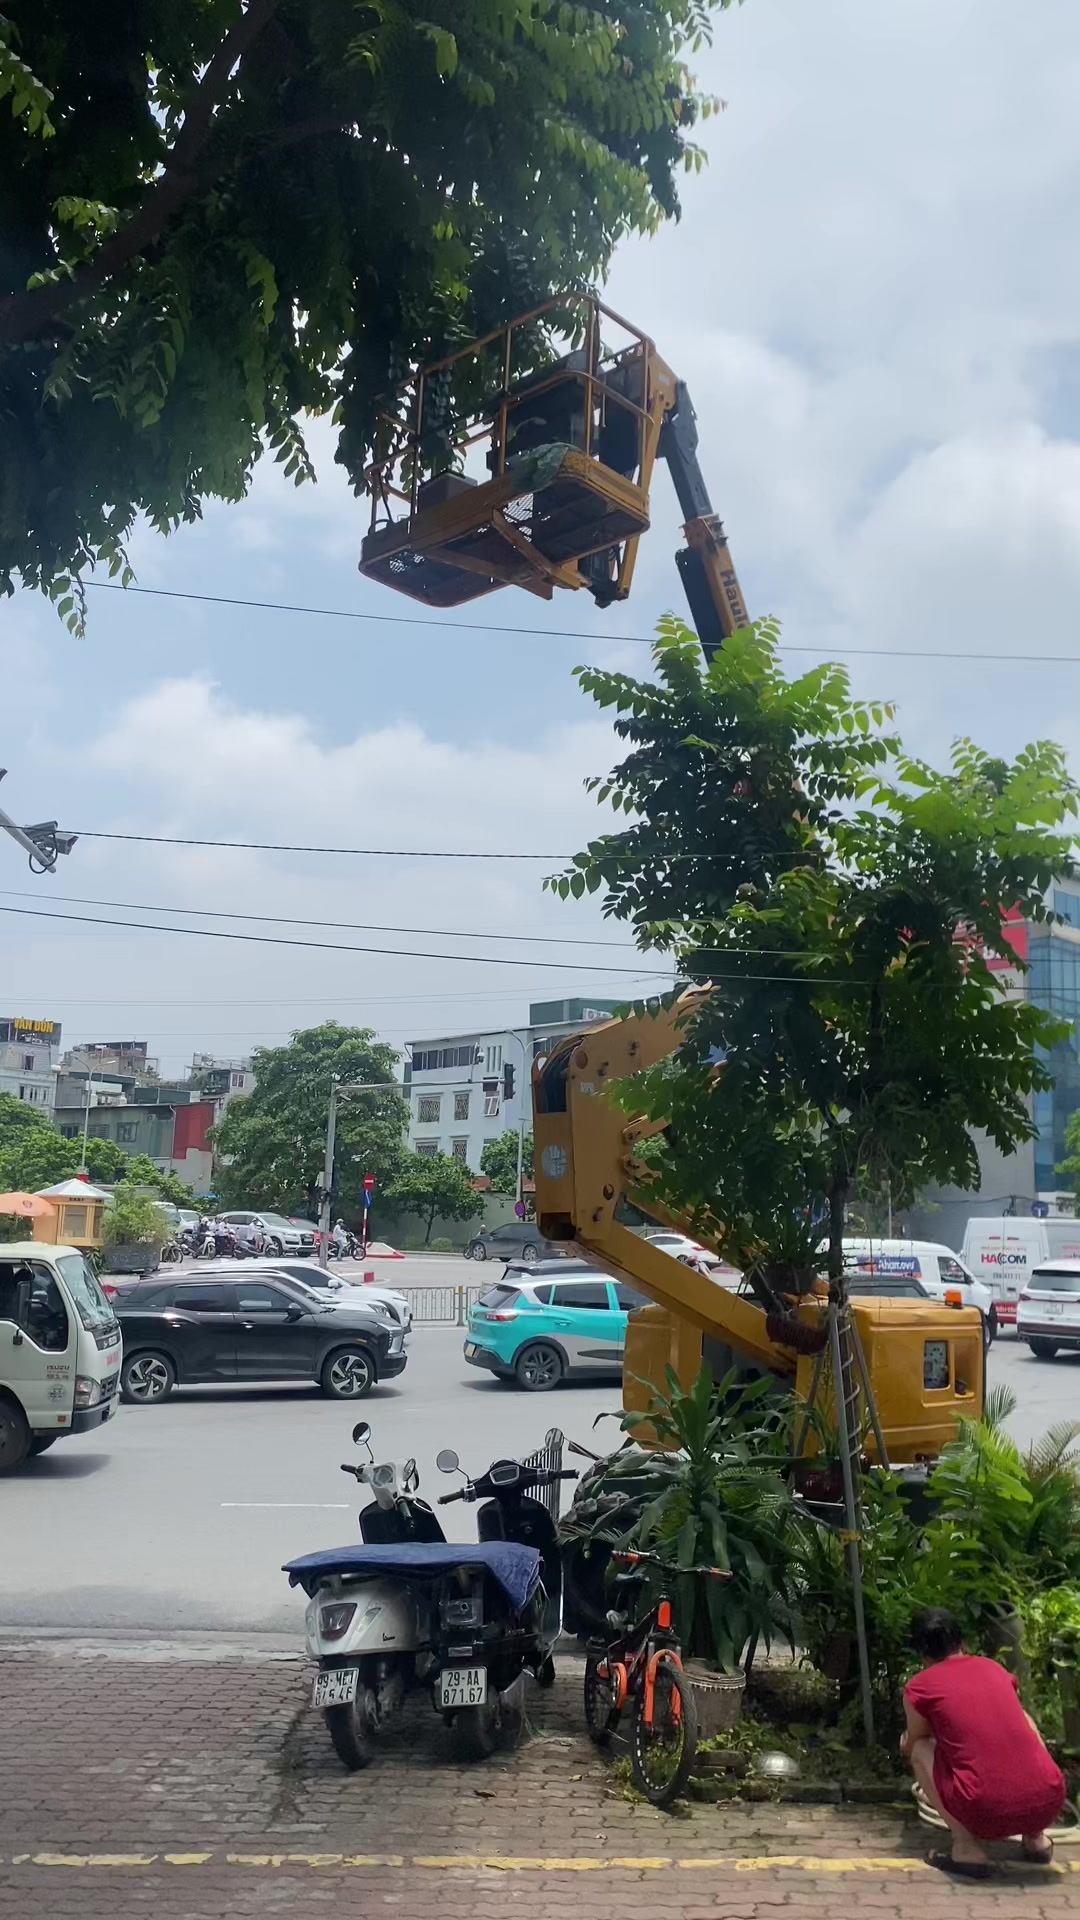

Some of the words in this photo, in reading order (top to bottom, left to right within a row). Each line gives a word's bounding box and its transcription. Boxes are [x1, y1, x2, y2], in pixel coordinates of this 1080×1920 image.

[981, 1253, 1027, 1265] HACOM
[447, 1670, 480, 1687] 29-AA
[443, 1687, 483, 1705] 871.67
